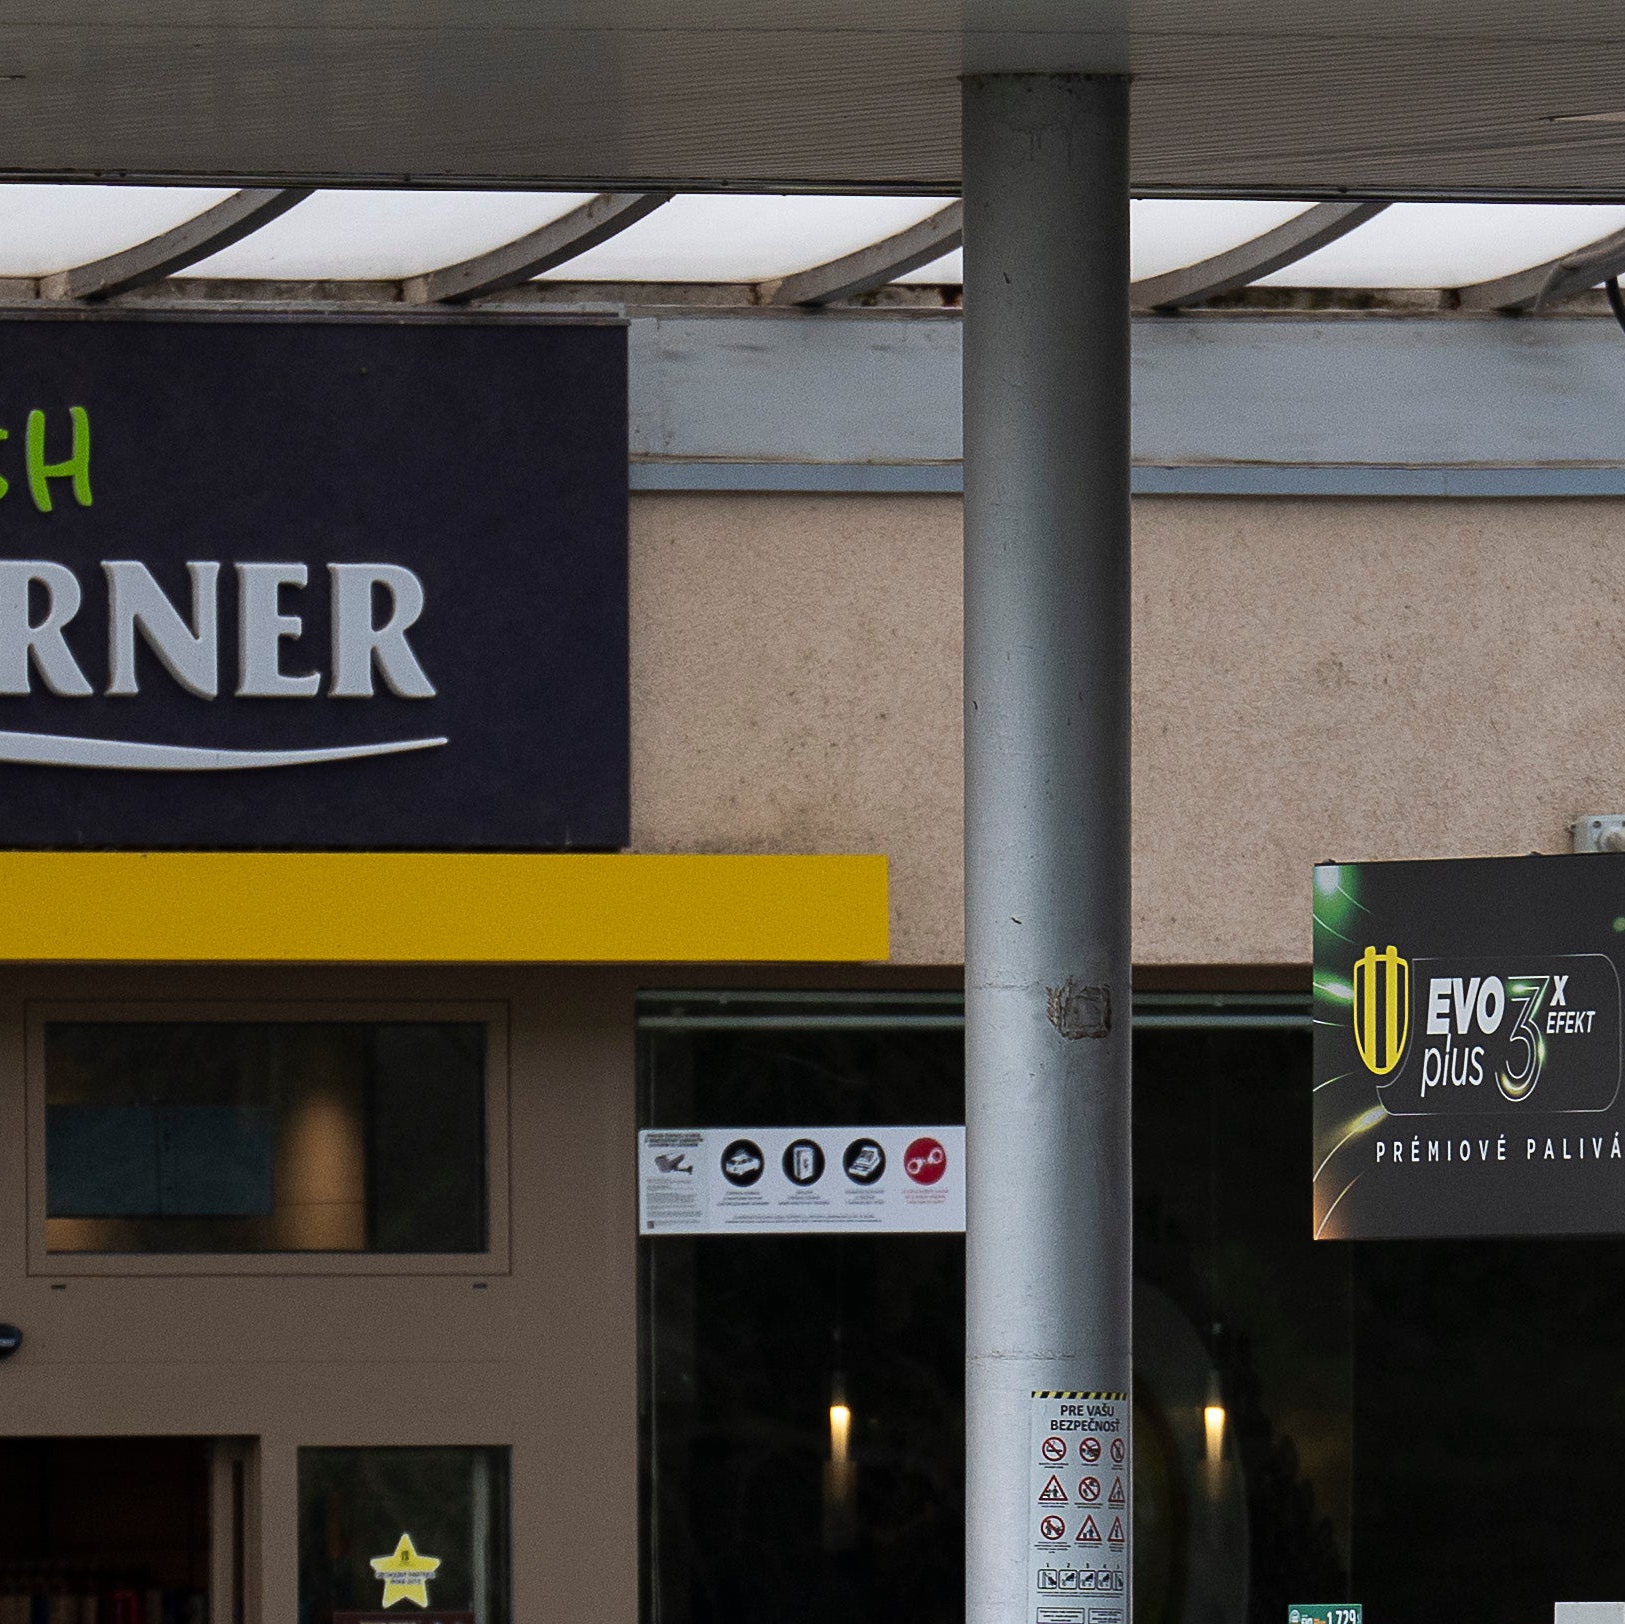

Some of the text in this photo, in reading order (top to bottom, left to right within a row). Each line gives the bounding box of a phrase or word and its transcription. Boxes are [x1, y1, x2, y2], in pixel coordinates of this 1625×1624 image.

[1426, 975, 1505, 1036] EVO
[1546, 1010, 1596, 1034] EFEKT
[1421, 1033, 1485, 1098] plus
[1376, 1131, 1623, 1163] PRÉMIOVÉ PALIVÁ
[1060, 1402, 1116, 1418] PRE VAŠU
